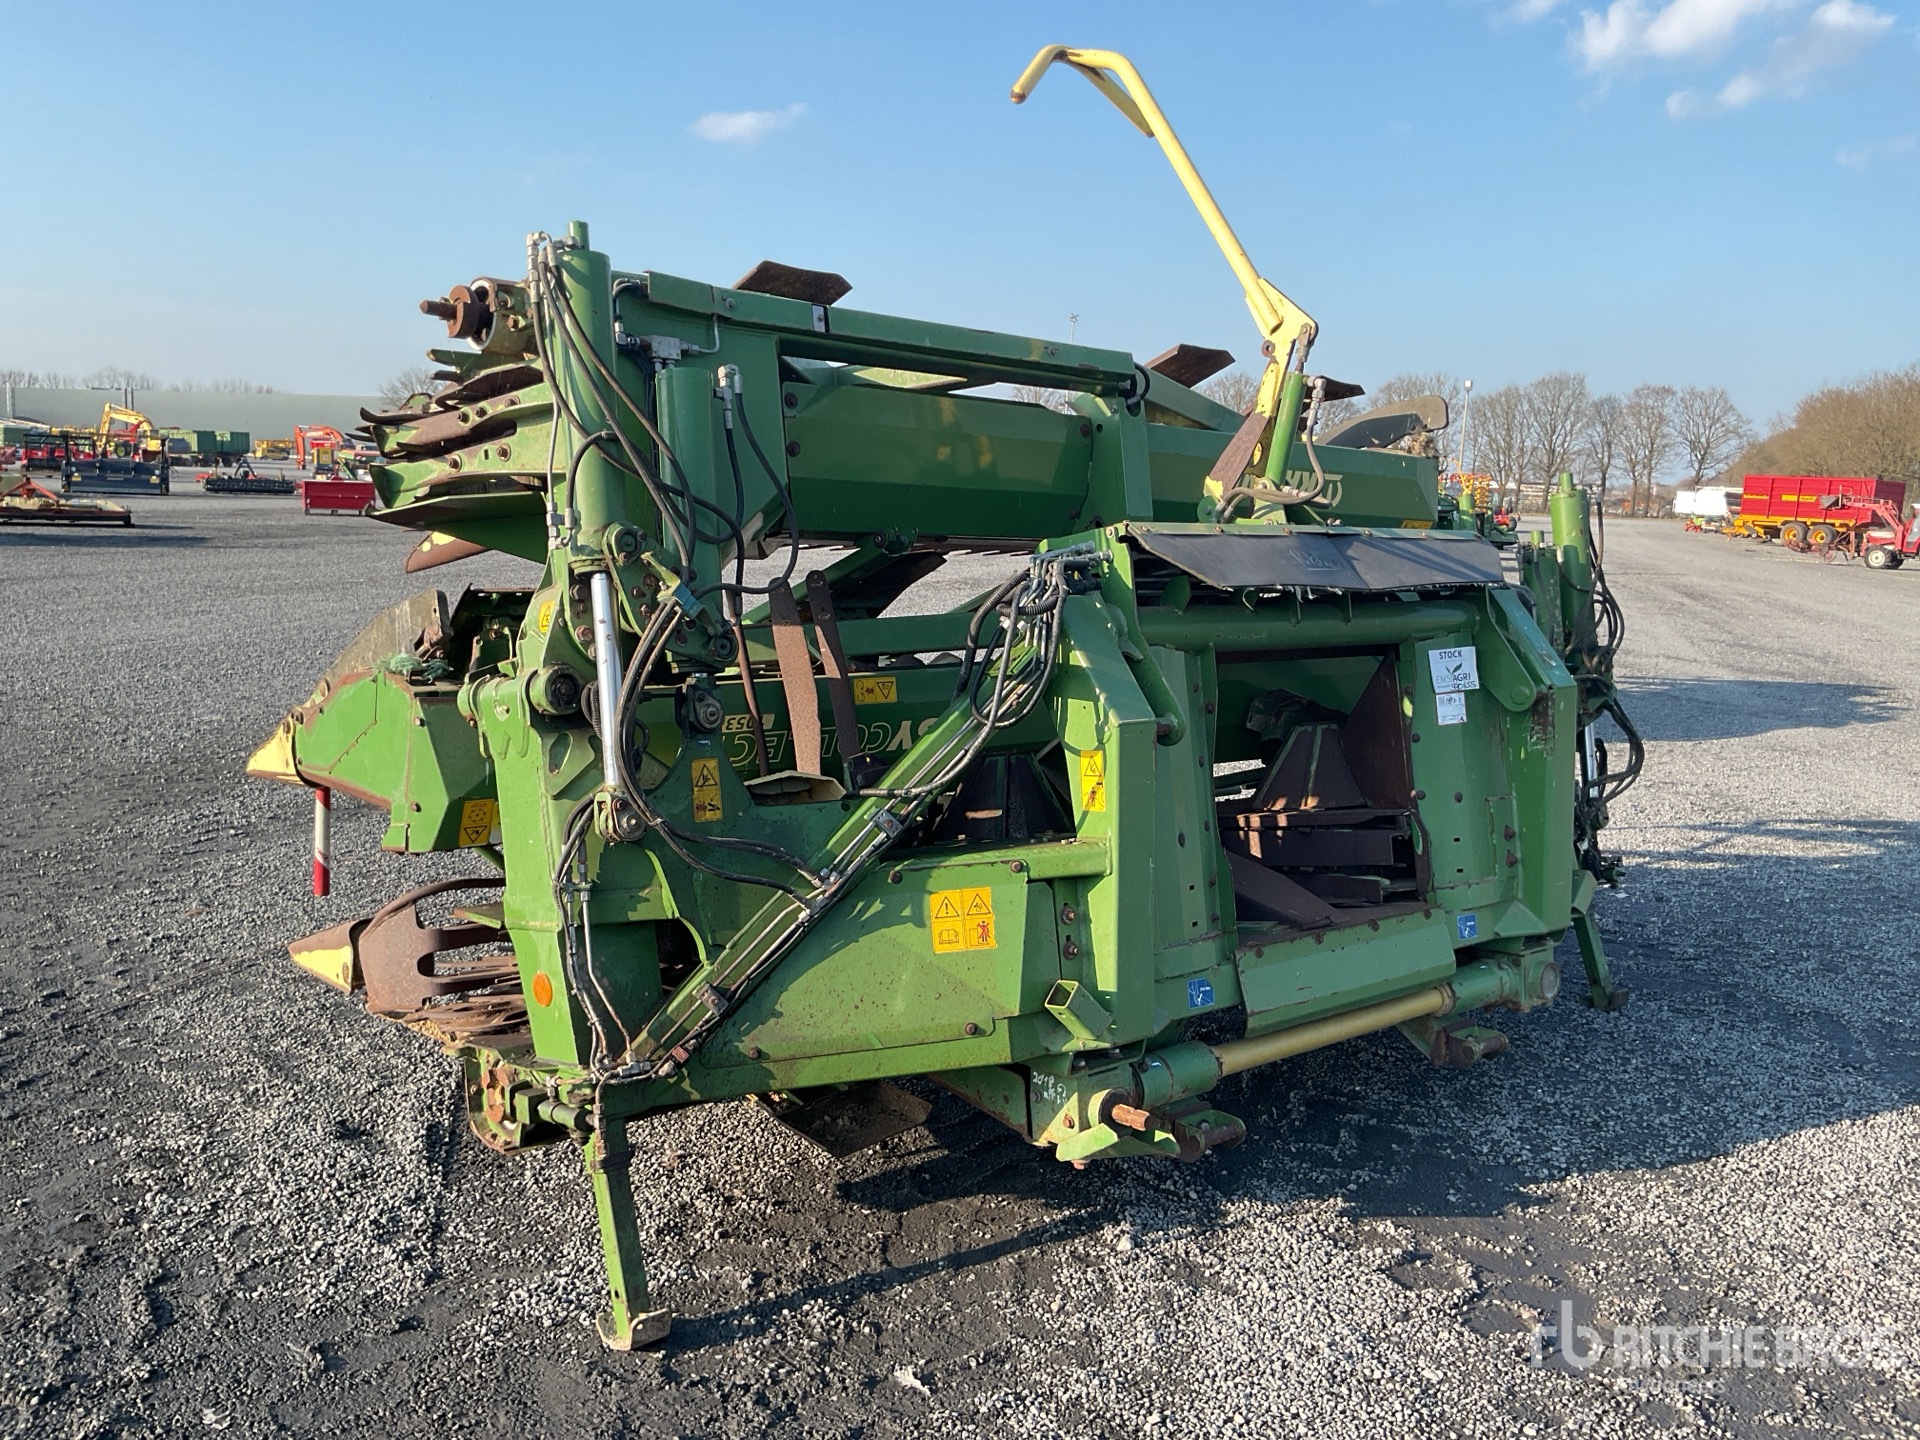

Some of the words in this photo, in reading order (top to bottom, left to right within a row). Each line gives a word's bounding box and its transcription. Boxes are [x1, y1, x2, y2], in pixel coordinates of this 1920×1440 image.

[1438, 650, 1463, 660] STOCK
[1436, 674, 1451, 684] EMS
[1452, 672, 1471, 682] AGRI
